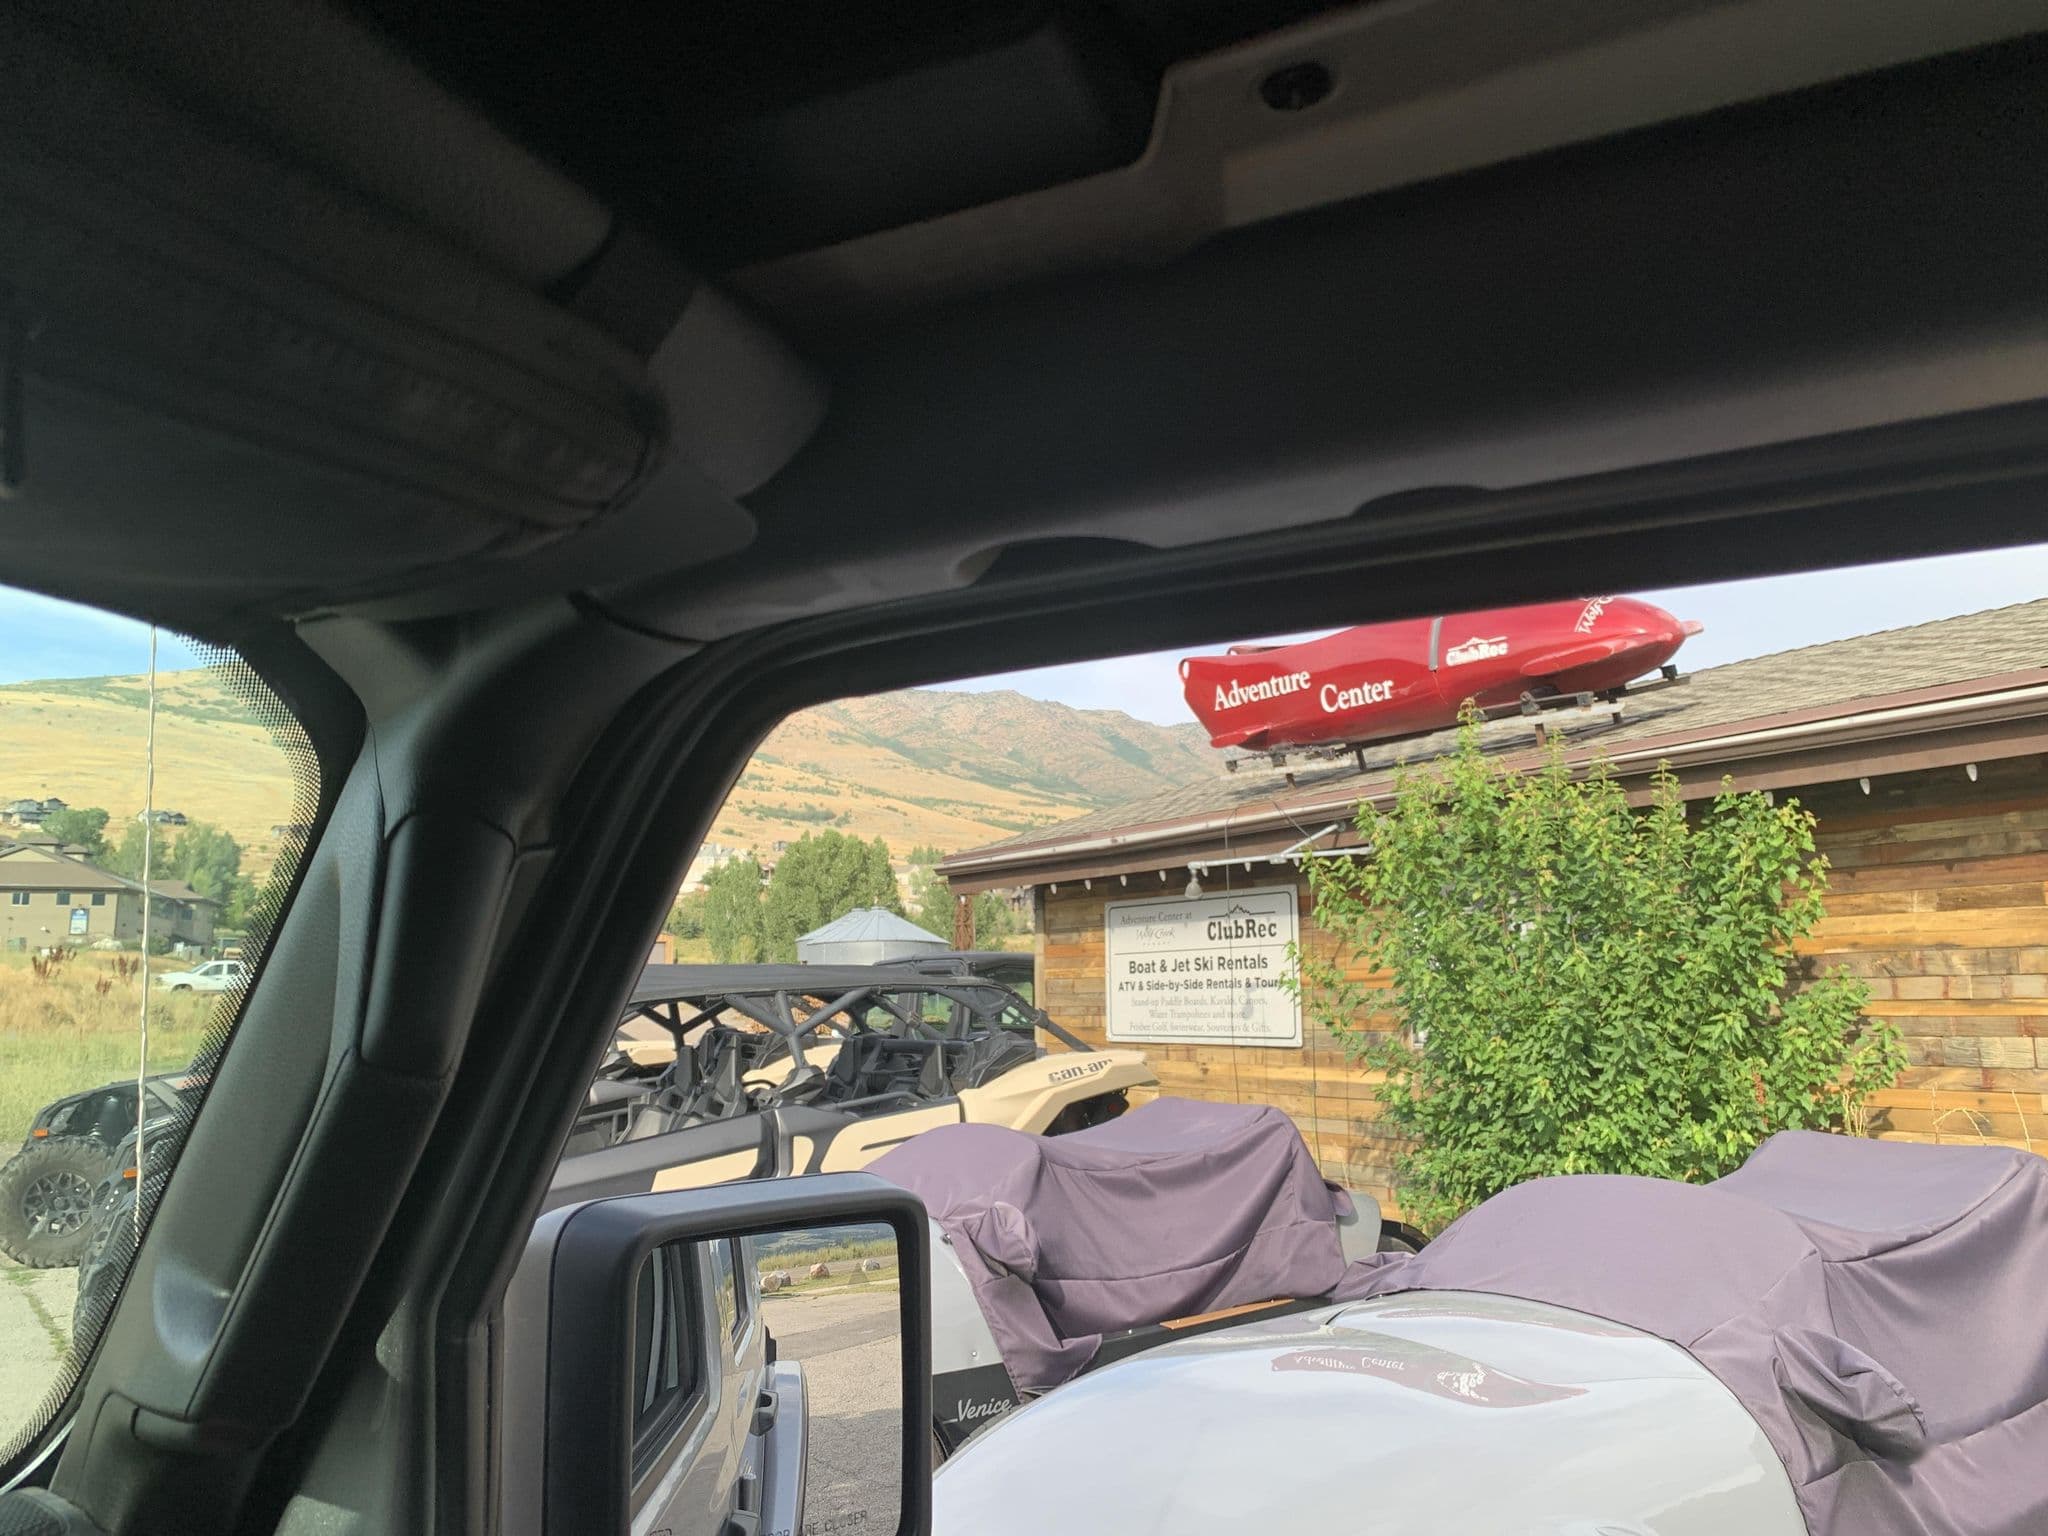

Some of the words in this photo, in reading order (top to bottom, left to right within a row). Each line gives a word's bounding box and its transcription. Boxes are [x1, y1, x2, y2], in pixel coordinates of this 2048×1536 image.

[1446, 642, 1508, 666] ClubRec
[1214, 671, 1311, 711] Adventure
[1320, 680, 1394, 713] Center
[1120, 913, 1156, 925] Adventure
[1158, 912, 1181, 921] Center
[1207, 918, 1277, 941] ClubRec
[1129, 960, 1156, 975] Boat
[1160, 959, 1167, 973] &
[1171, 958, 1190, 973] Jet
[1194, 957, 1213, 971] Ski
[1217, 954, 1268, 971] Rentals
[1118, 981, 1136, 992] ATV
[1138, 980, 1144, 991] &
[1146, 978, 1203, 992] Side-by-Side
[1206, 977, 1242, 990] Rentals
[1245, 976, 1252, 989] &
[1254, 976, 1281, 989] Tour
[957, 1397, 1013, 1422] Venice
